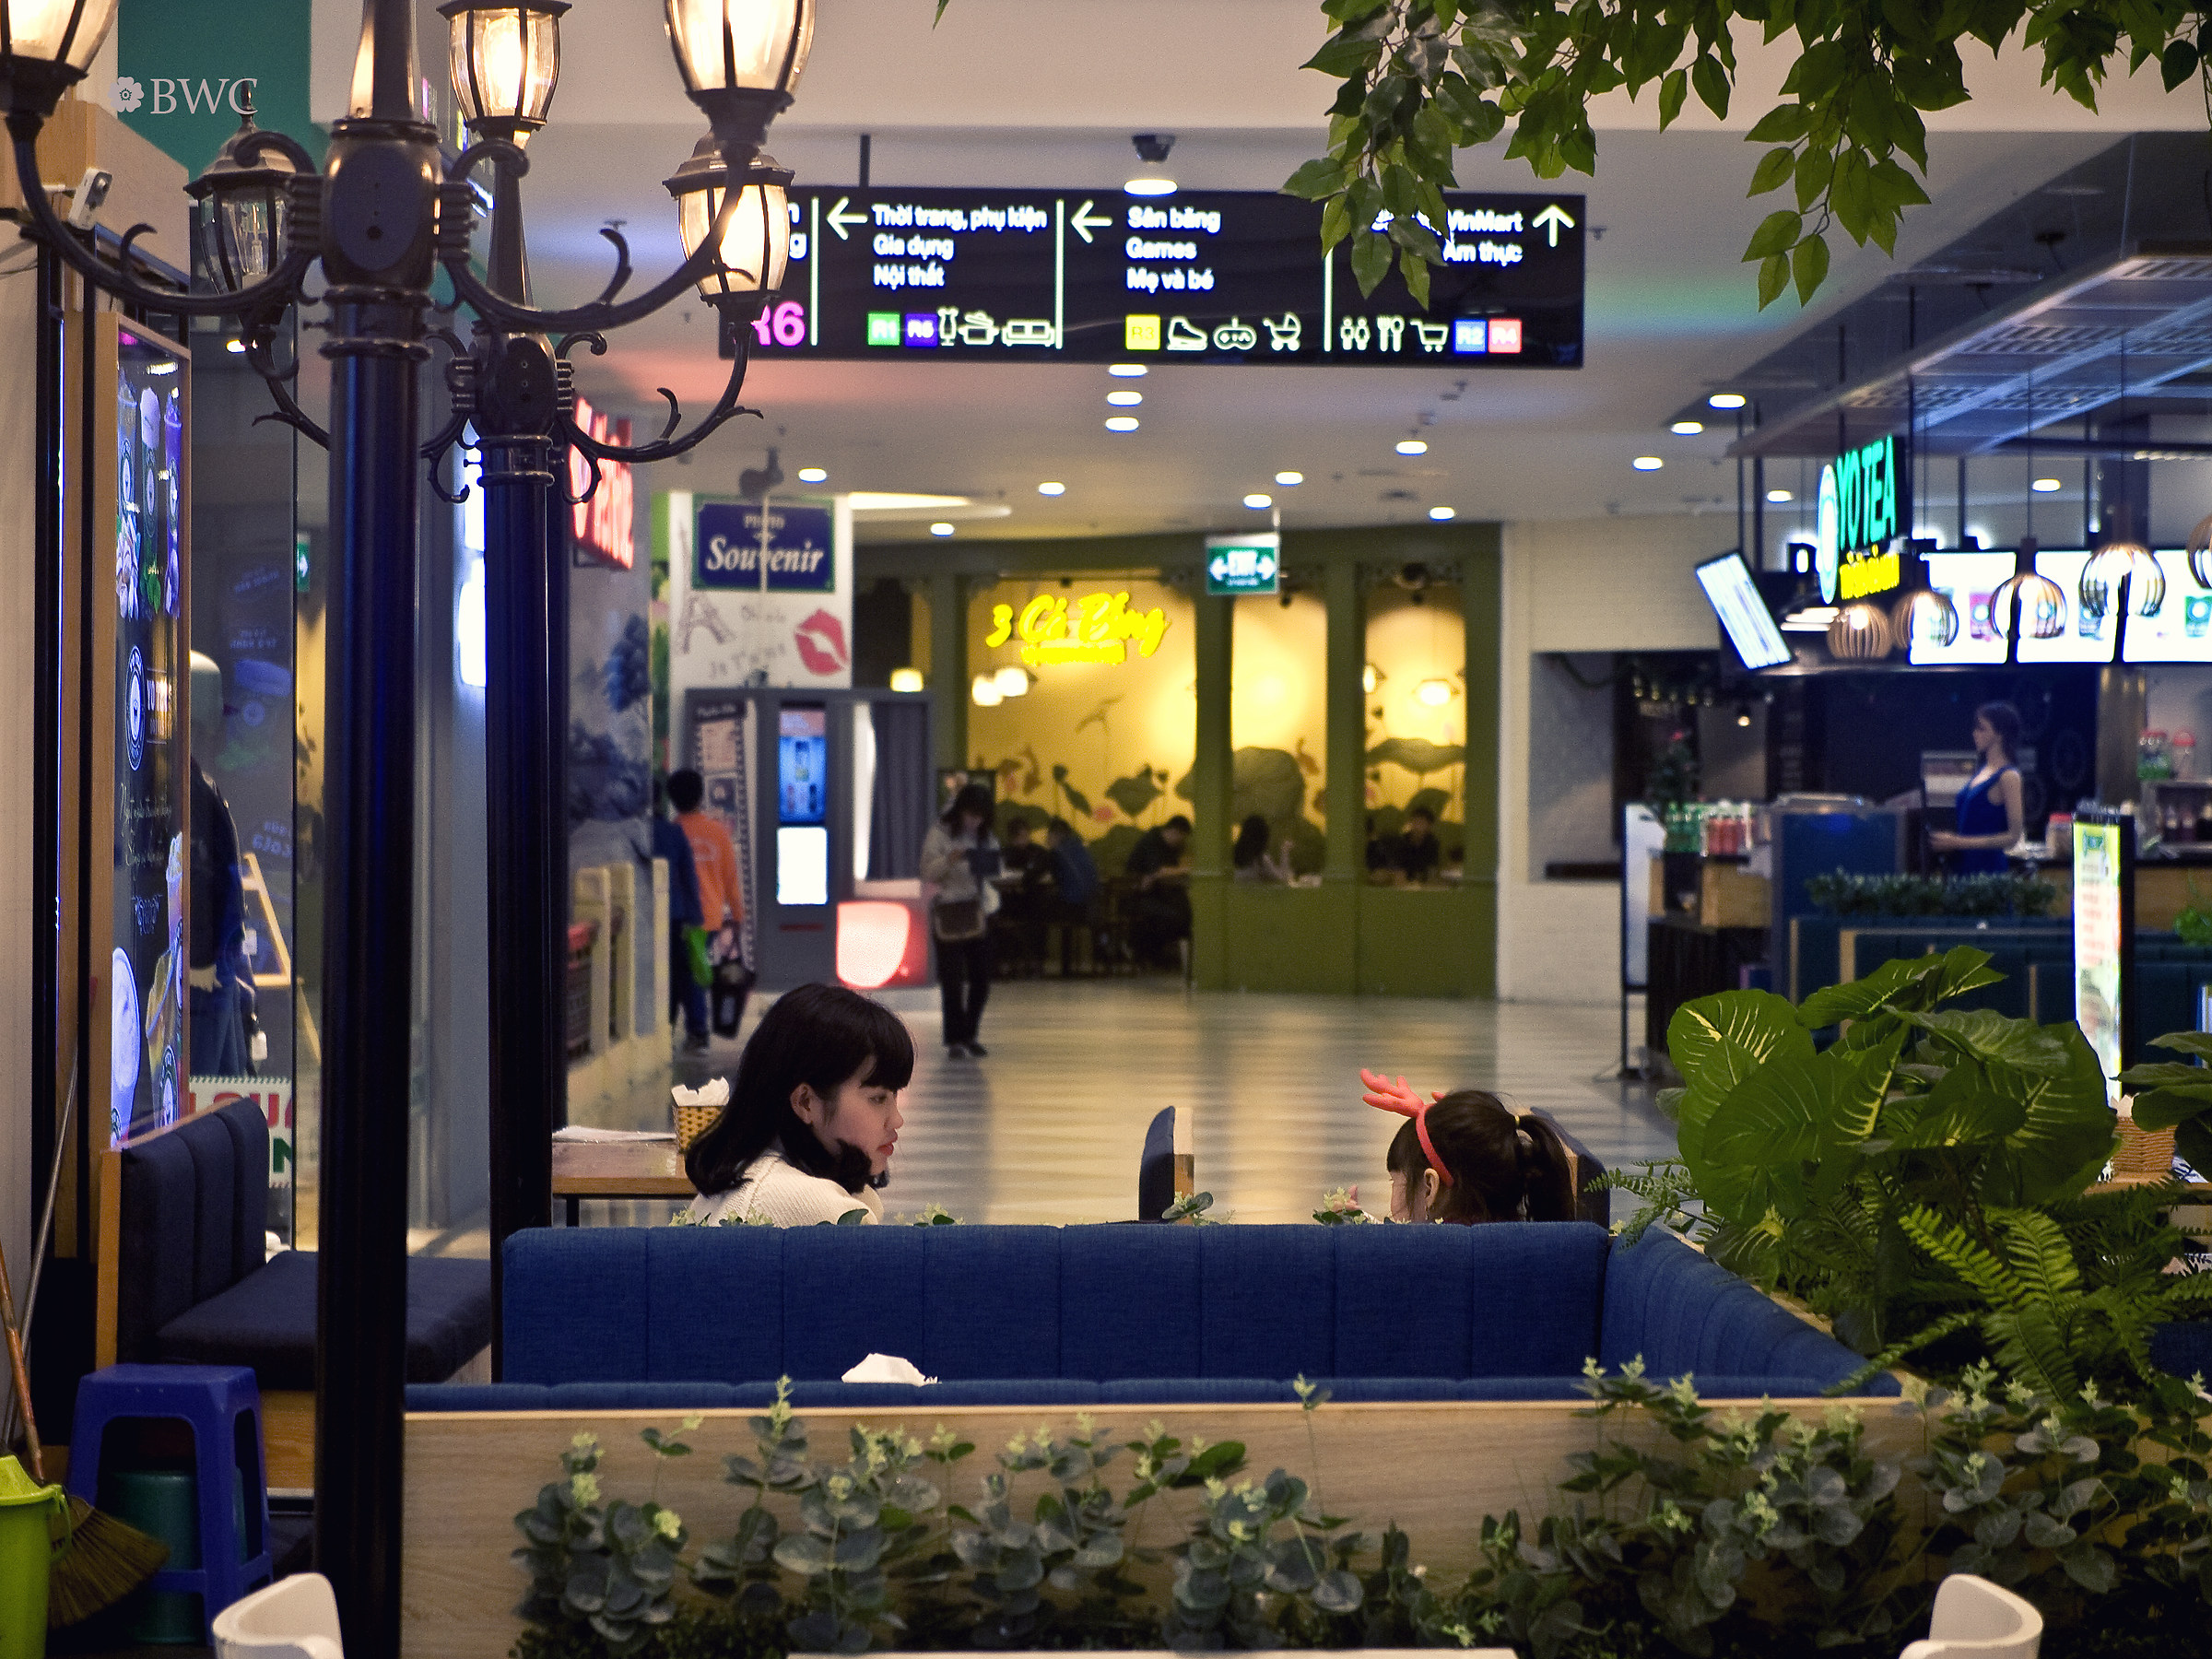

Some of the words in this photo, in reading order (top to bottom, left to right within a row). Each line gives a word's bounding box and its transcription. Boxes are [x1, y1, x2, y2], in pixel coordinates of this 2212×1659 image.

[871, 203, 913, 227] Thời
[970, 205, 1006, 232] phụ
[1127, 206, 1168, 229] Sân
[873, 232, 905, 256] Gia
[906, 233, 955, 261] dụng
[1125, 236, 1197, 259] Games
[873, 263, 906, 291] Nội
[1160, 267, 1186, 290] và
[1187, 267, 1215, 290] bé
[872, 319, 896, 339] R1
[1132, 326, 1154, 340] R3
[1456, 326, 1484, 346] R2
[1490, 327, 1518, 346] R4
